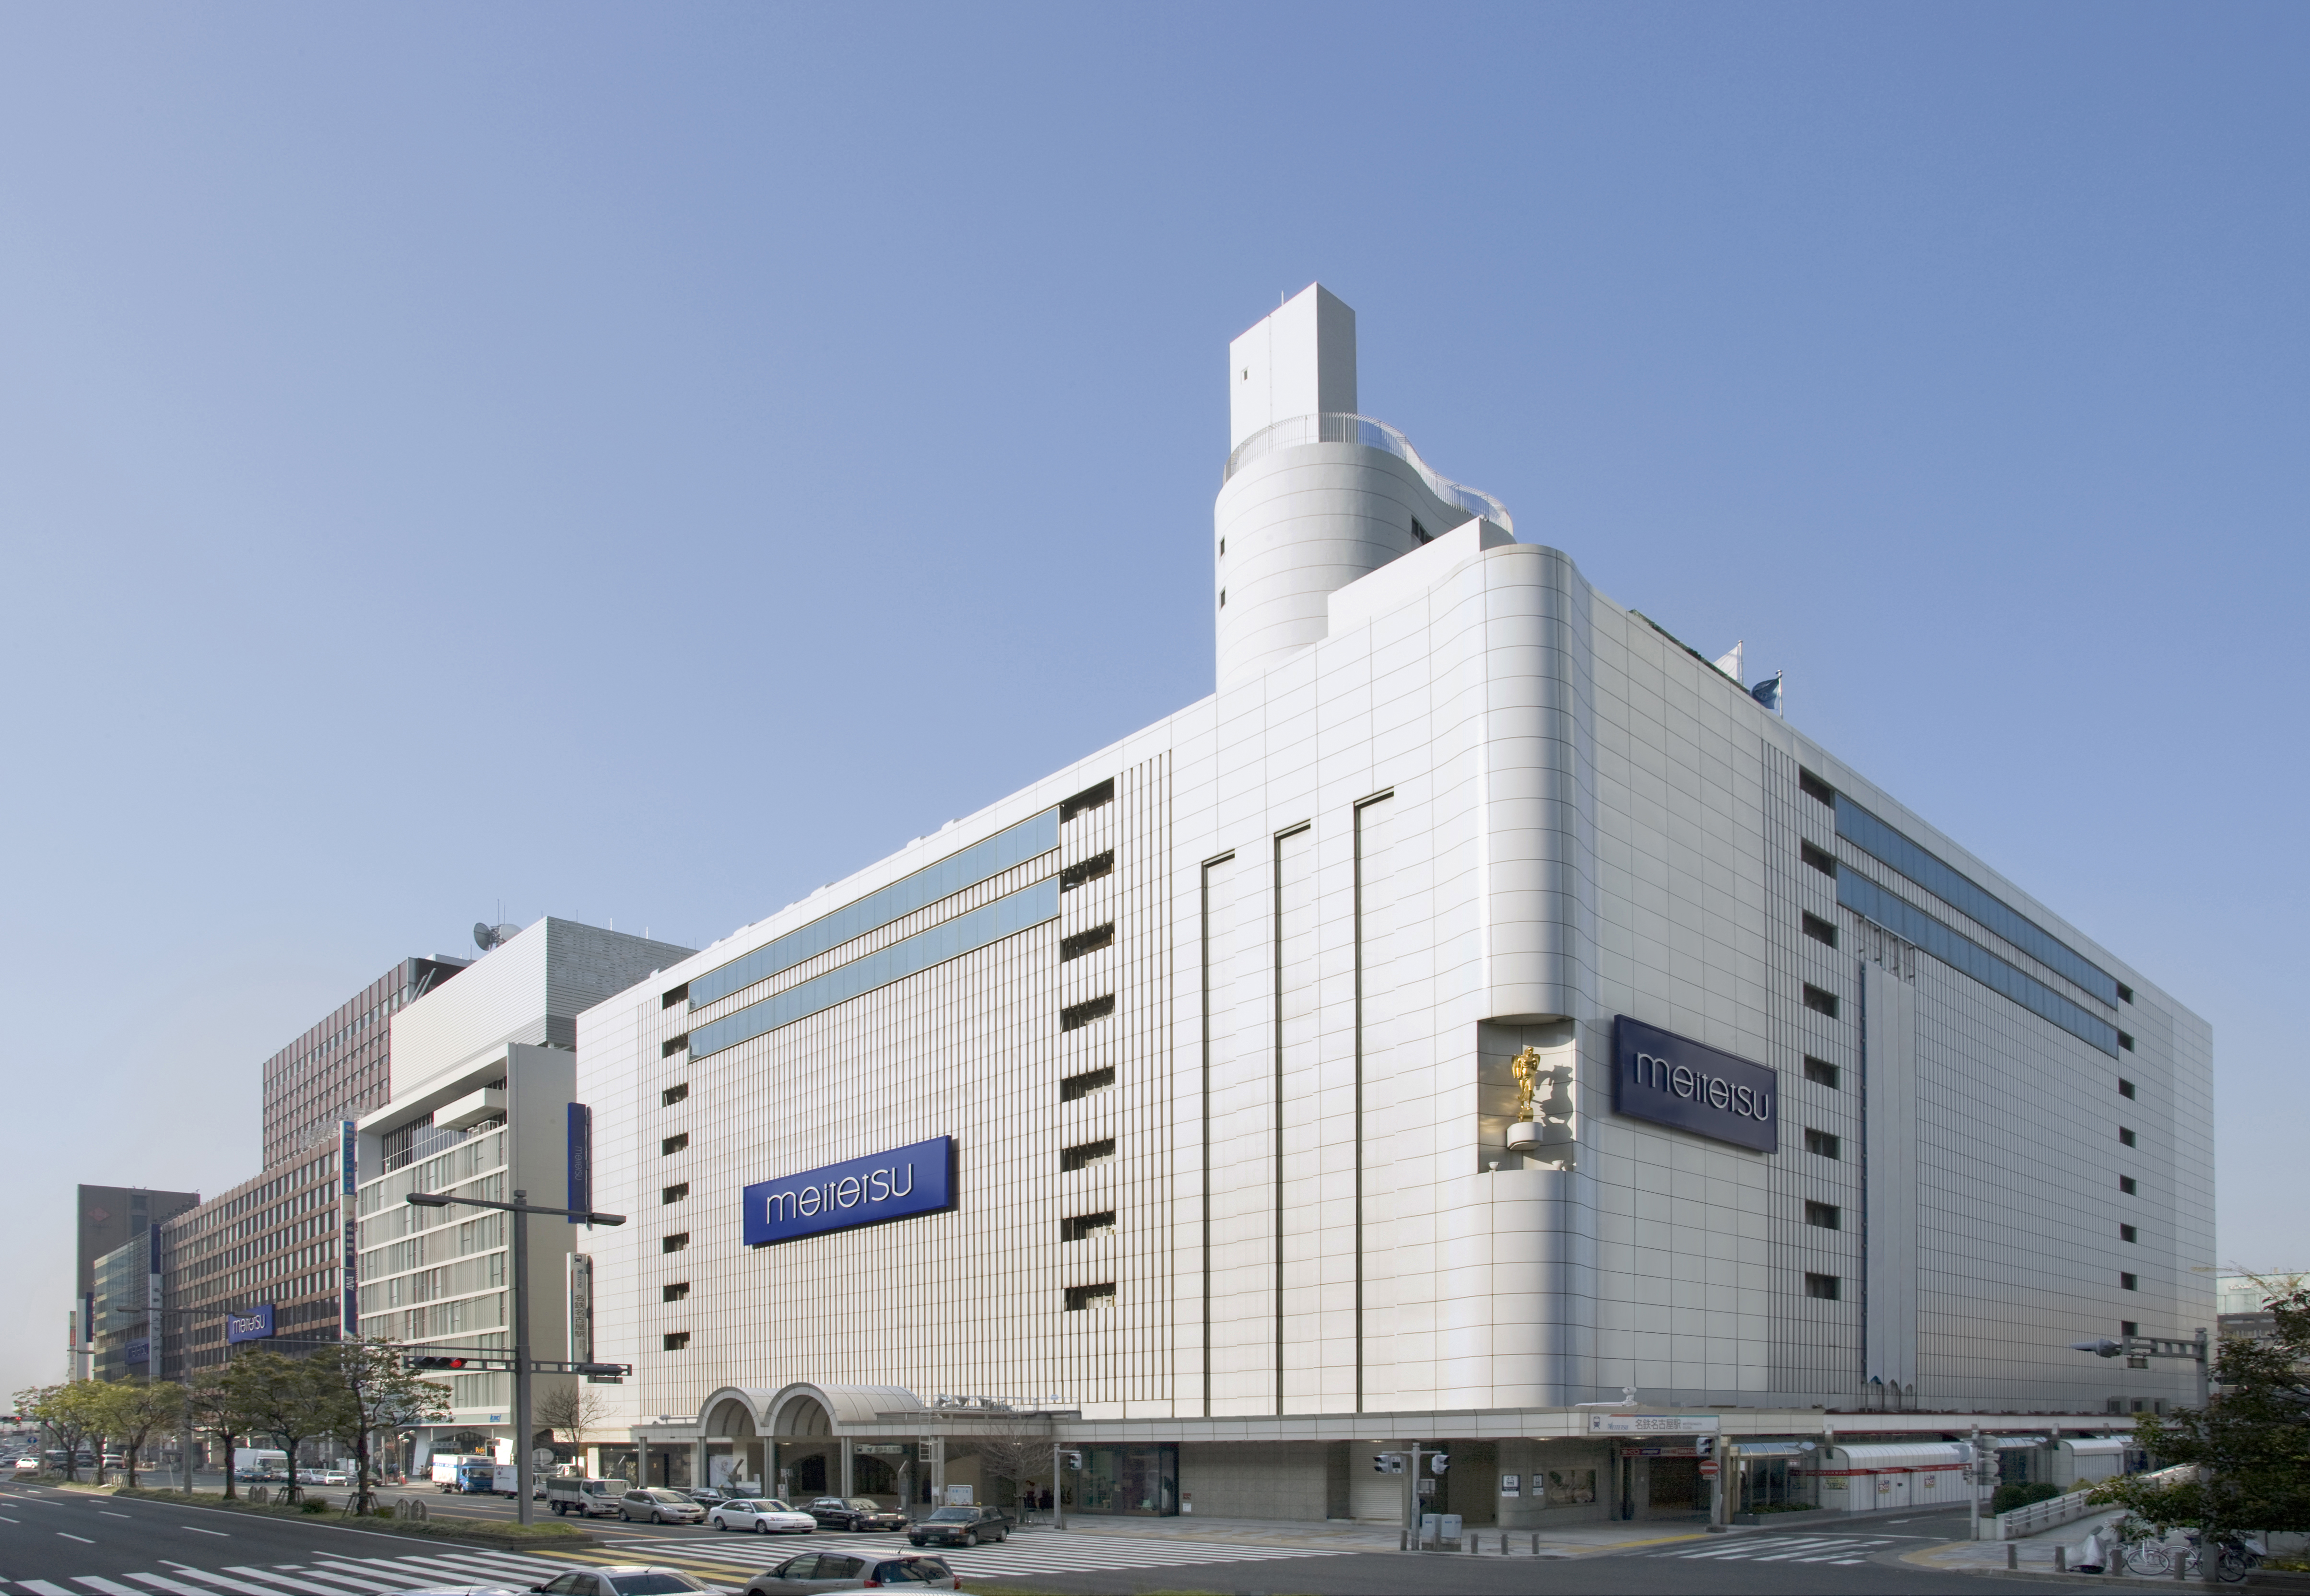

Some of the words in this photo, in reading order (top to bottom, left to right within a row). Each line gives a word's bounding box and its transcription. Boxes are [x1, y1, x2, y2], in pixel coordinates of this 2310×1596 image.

[1637, 1052, 1768, 1121] meitetsu
[767, 1163, 912, 1224] meitetsu
[346, 1226, 354, 1256] 名鉄観光
[346, 1276, 354, 1291] ANA
[233, 1314, 265, 1334] meitetsu
[575, 1294, 585, 1338] 名鉄名古屋駅
[1608, 1422, 1628, 1430] MEITETSU
[1635, 1419, 1681, 1430] 名鉄名古屋駅
